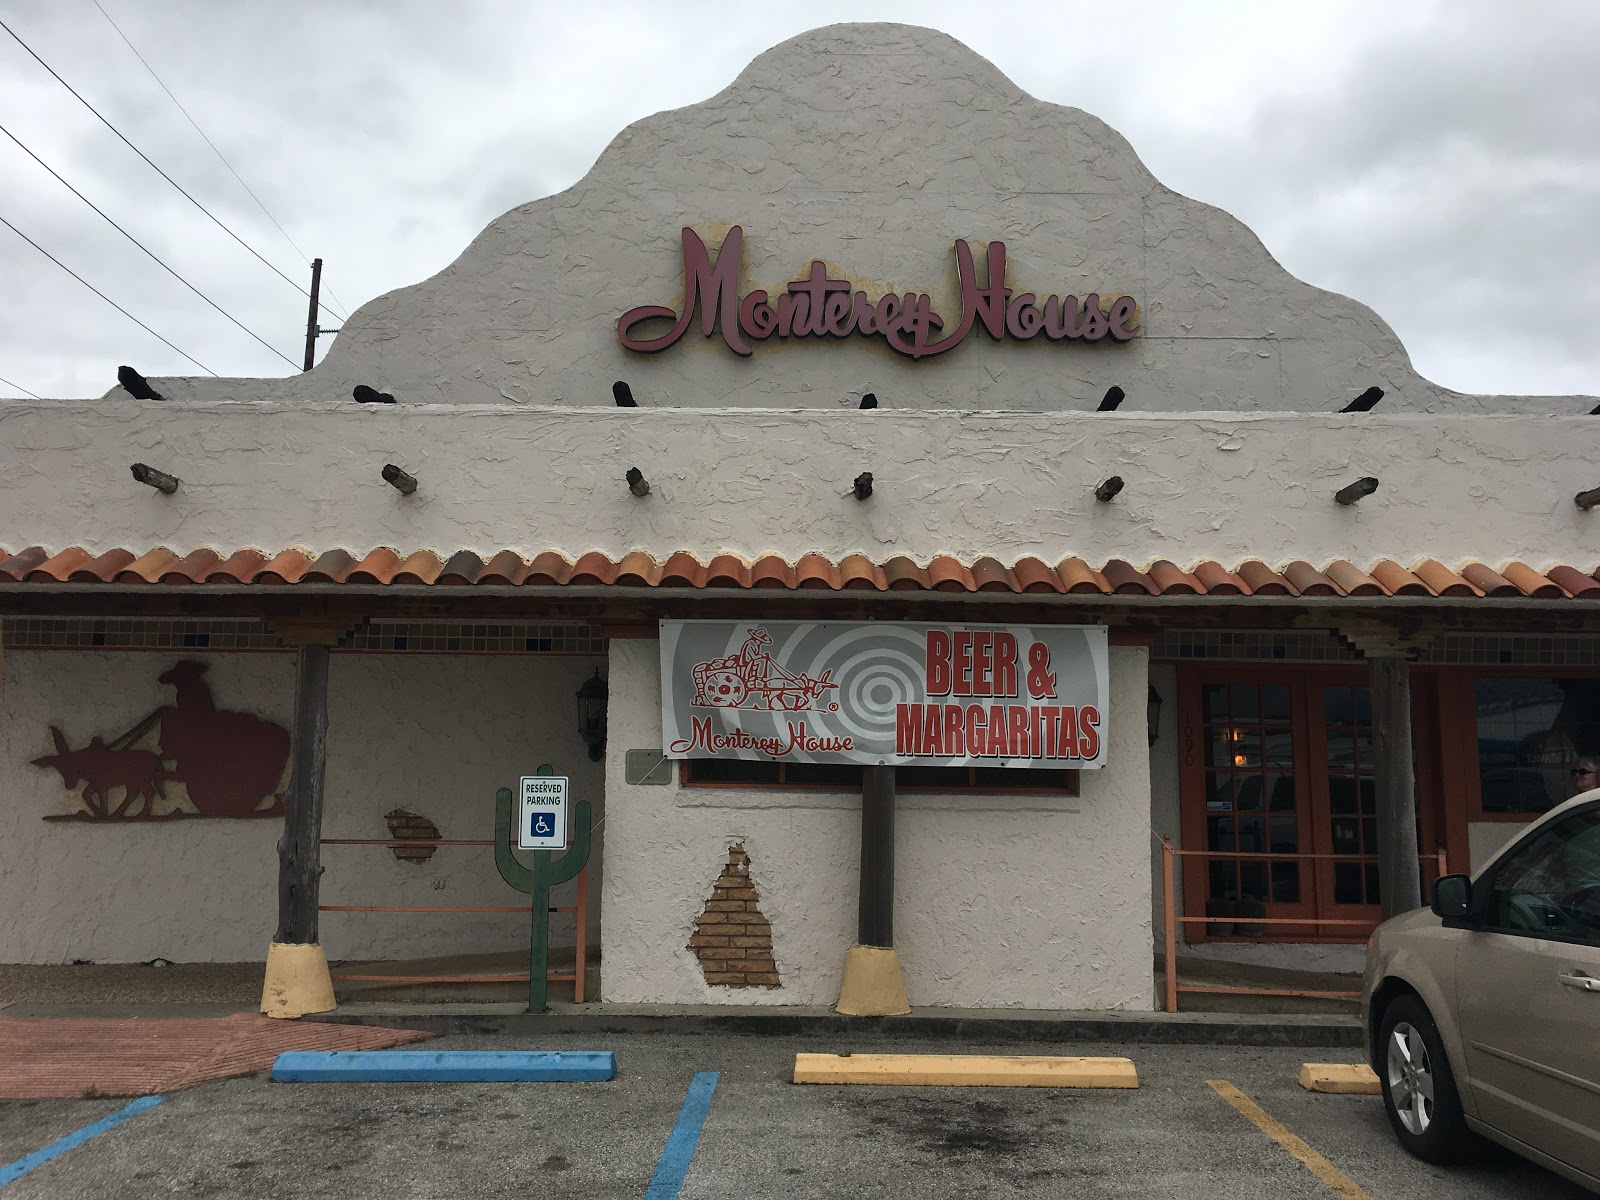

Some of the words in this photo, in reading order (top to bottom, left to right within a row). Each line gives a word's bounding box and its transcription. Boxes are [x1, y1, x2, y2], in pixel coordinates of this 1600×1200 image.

[617, 224, 944, 359] Monterey
[888, 238, 1141, 359] House
[925, 629, 1019, 698] BEER
[1027, 641, 1057, 699] &
[670, 715, 783, 757] Monterey
[772, 721, 854, 755] House
[896, 703, 1100, 761] MARGARITAS
[1182, 711, 1194, 767] 1090
[526, 784, 562, 793] RESERVED
[526, 796, 561, 805] PARKING
